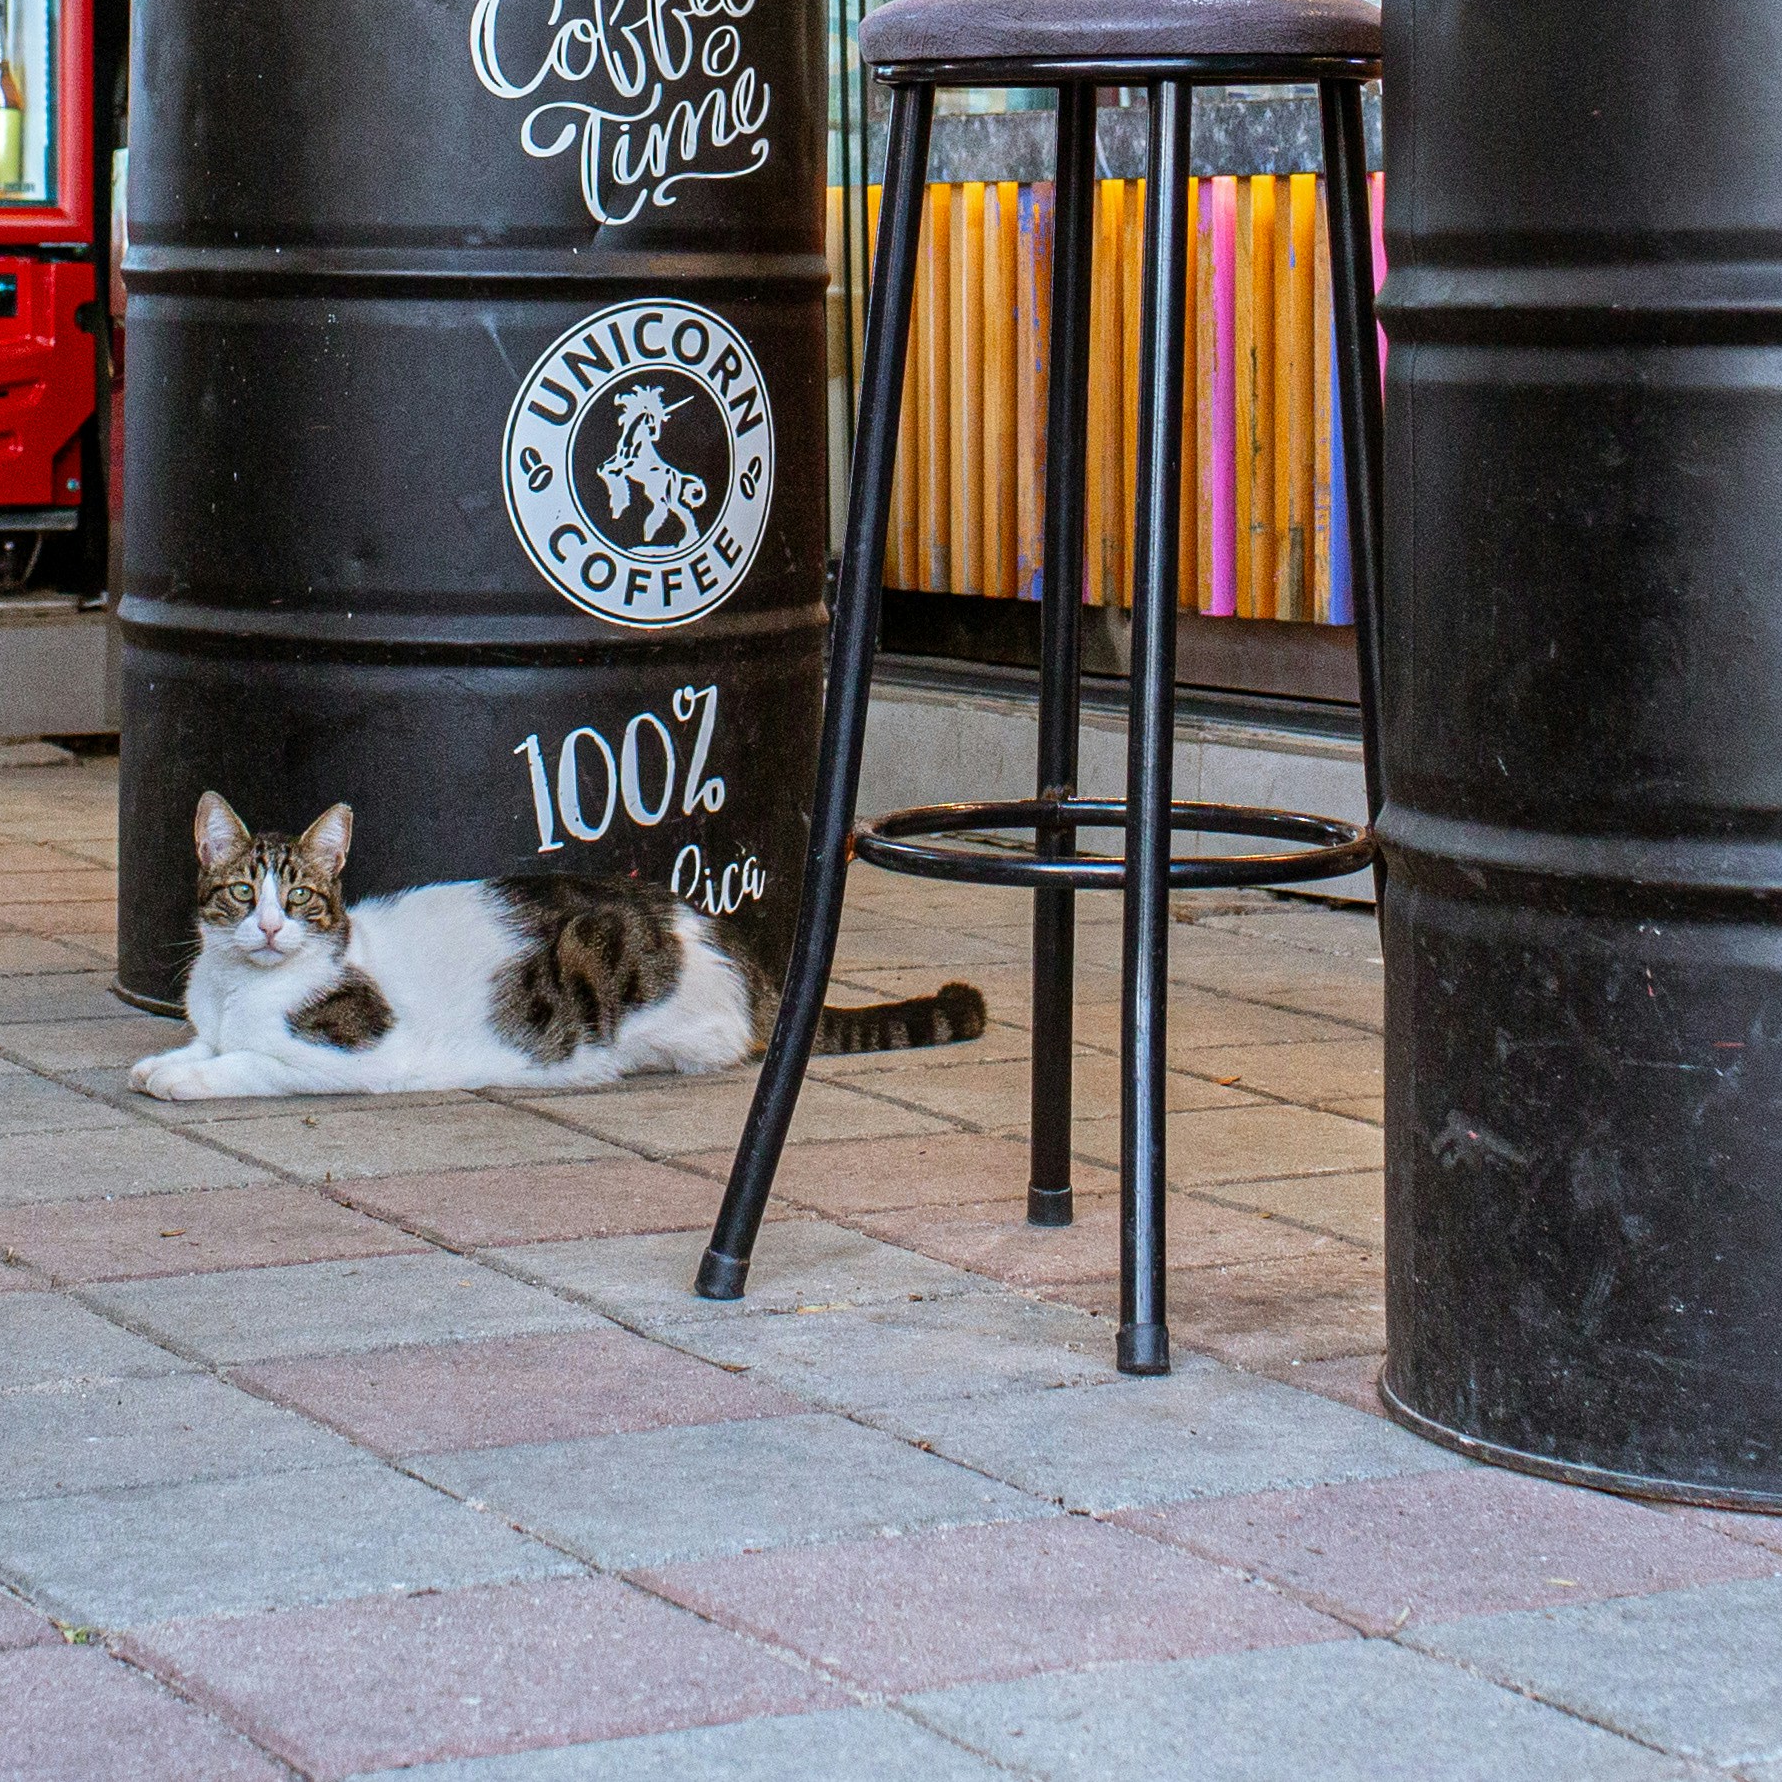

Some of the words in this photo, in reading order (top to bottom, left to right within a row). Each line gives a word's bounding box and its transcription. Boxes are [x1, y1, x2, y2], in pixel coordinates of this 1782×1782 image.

[521, 68, 770, 225] Time
[527, 312, 764, 437] UNICORN
[548, 523, 743, 607] COFFEE
[513, 685, 726, 853] 100%
